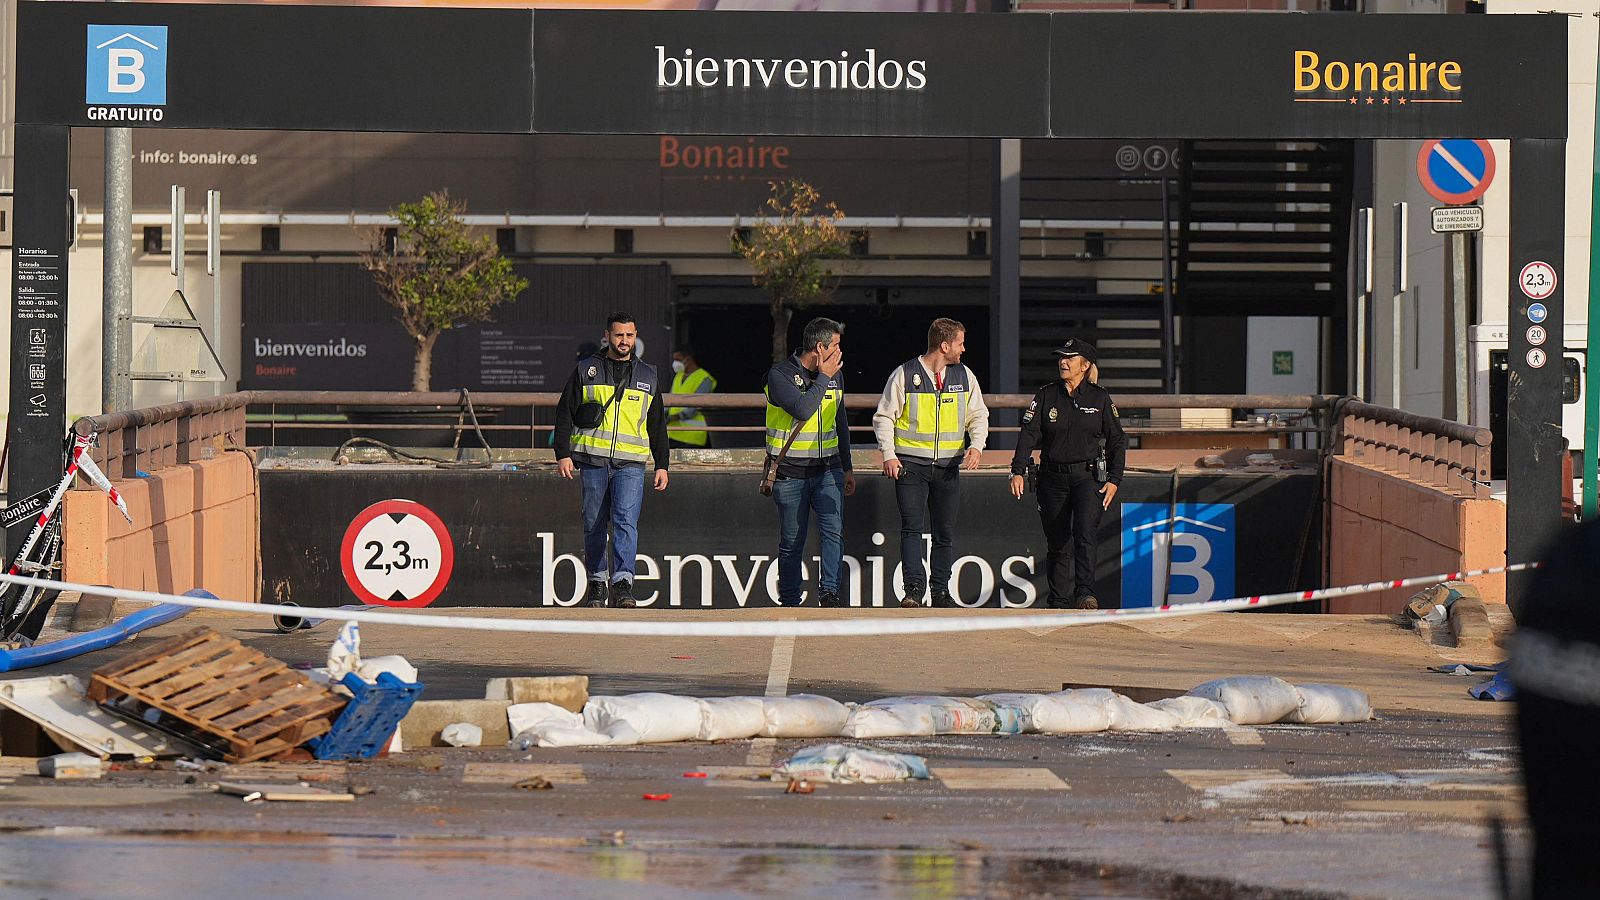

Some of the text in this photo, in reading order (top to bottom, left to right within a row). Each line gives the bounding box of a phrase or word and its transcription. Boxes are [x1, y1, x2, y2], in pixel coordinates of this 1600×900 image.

[108, 48, 146, 93] B
[655, 46, 927, 89] bienvenidos
[1294, 50, 1462, 91] Bonaire
[87, 107, 163, 121] GRATUITO
[140, 150, 258, 165] info: bonaire.es
[660, 136, 789, 168] Bonaire
[18, 247, 48, 255] Horarios
[1531, 329, 1542, 338] 20
[254, 338, 367, 357] bienvenidos
[255, 364, 297, 376] Bonaire
[0, 497, 41, 523] Bonaire
[364, 540, 429, 576] 2,3m
[536, 532, 1037, 608] benvenidos
